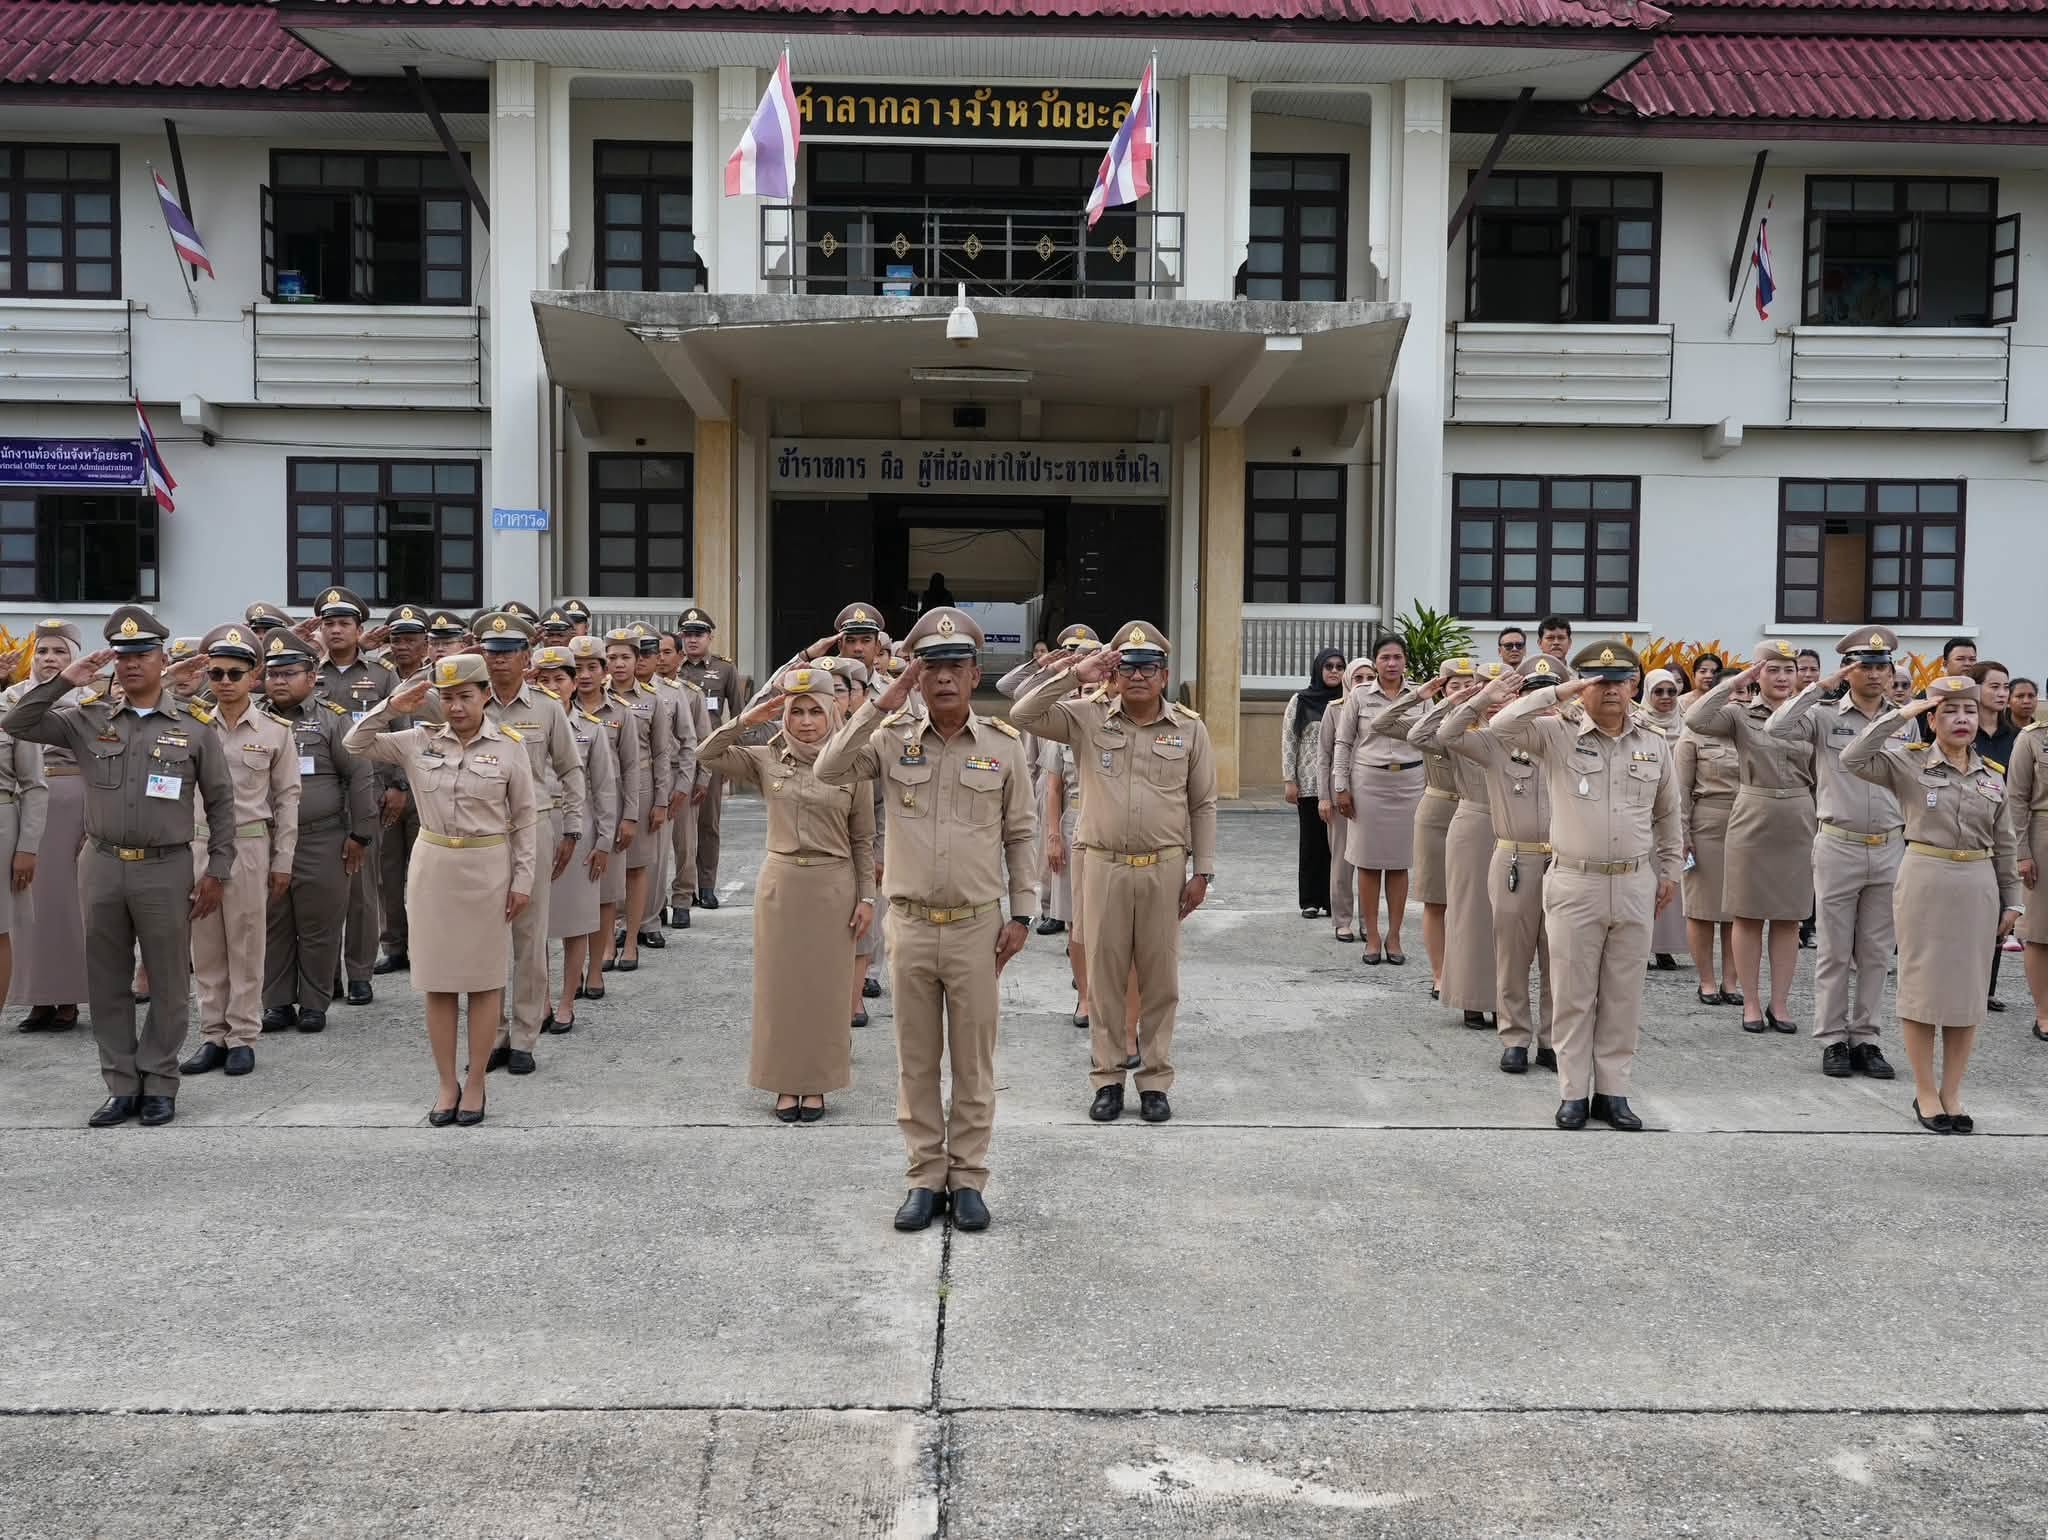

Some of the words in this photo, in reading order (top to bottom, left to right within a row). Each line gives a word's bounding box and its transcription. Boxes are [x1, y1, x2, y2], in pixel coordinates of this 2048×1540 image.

[796, 86, 1131, 129] ศาลากลางจังหวัดยะล
[24, 462, 45, 470] Office
[46, 462, 57, 471] for
[58, 463, 77, 471] Local
[79, 463, 133, 472] Administration
[778, 447, 866, 480] ข้าราชการ
[881, 450, 904, 481] คือ
